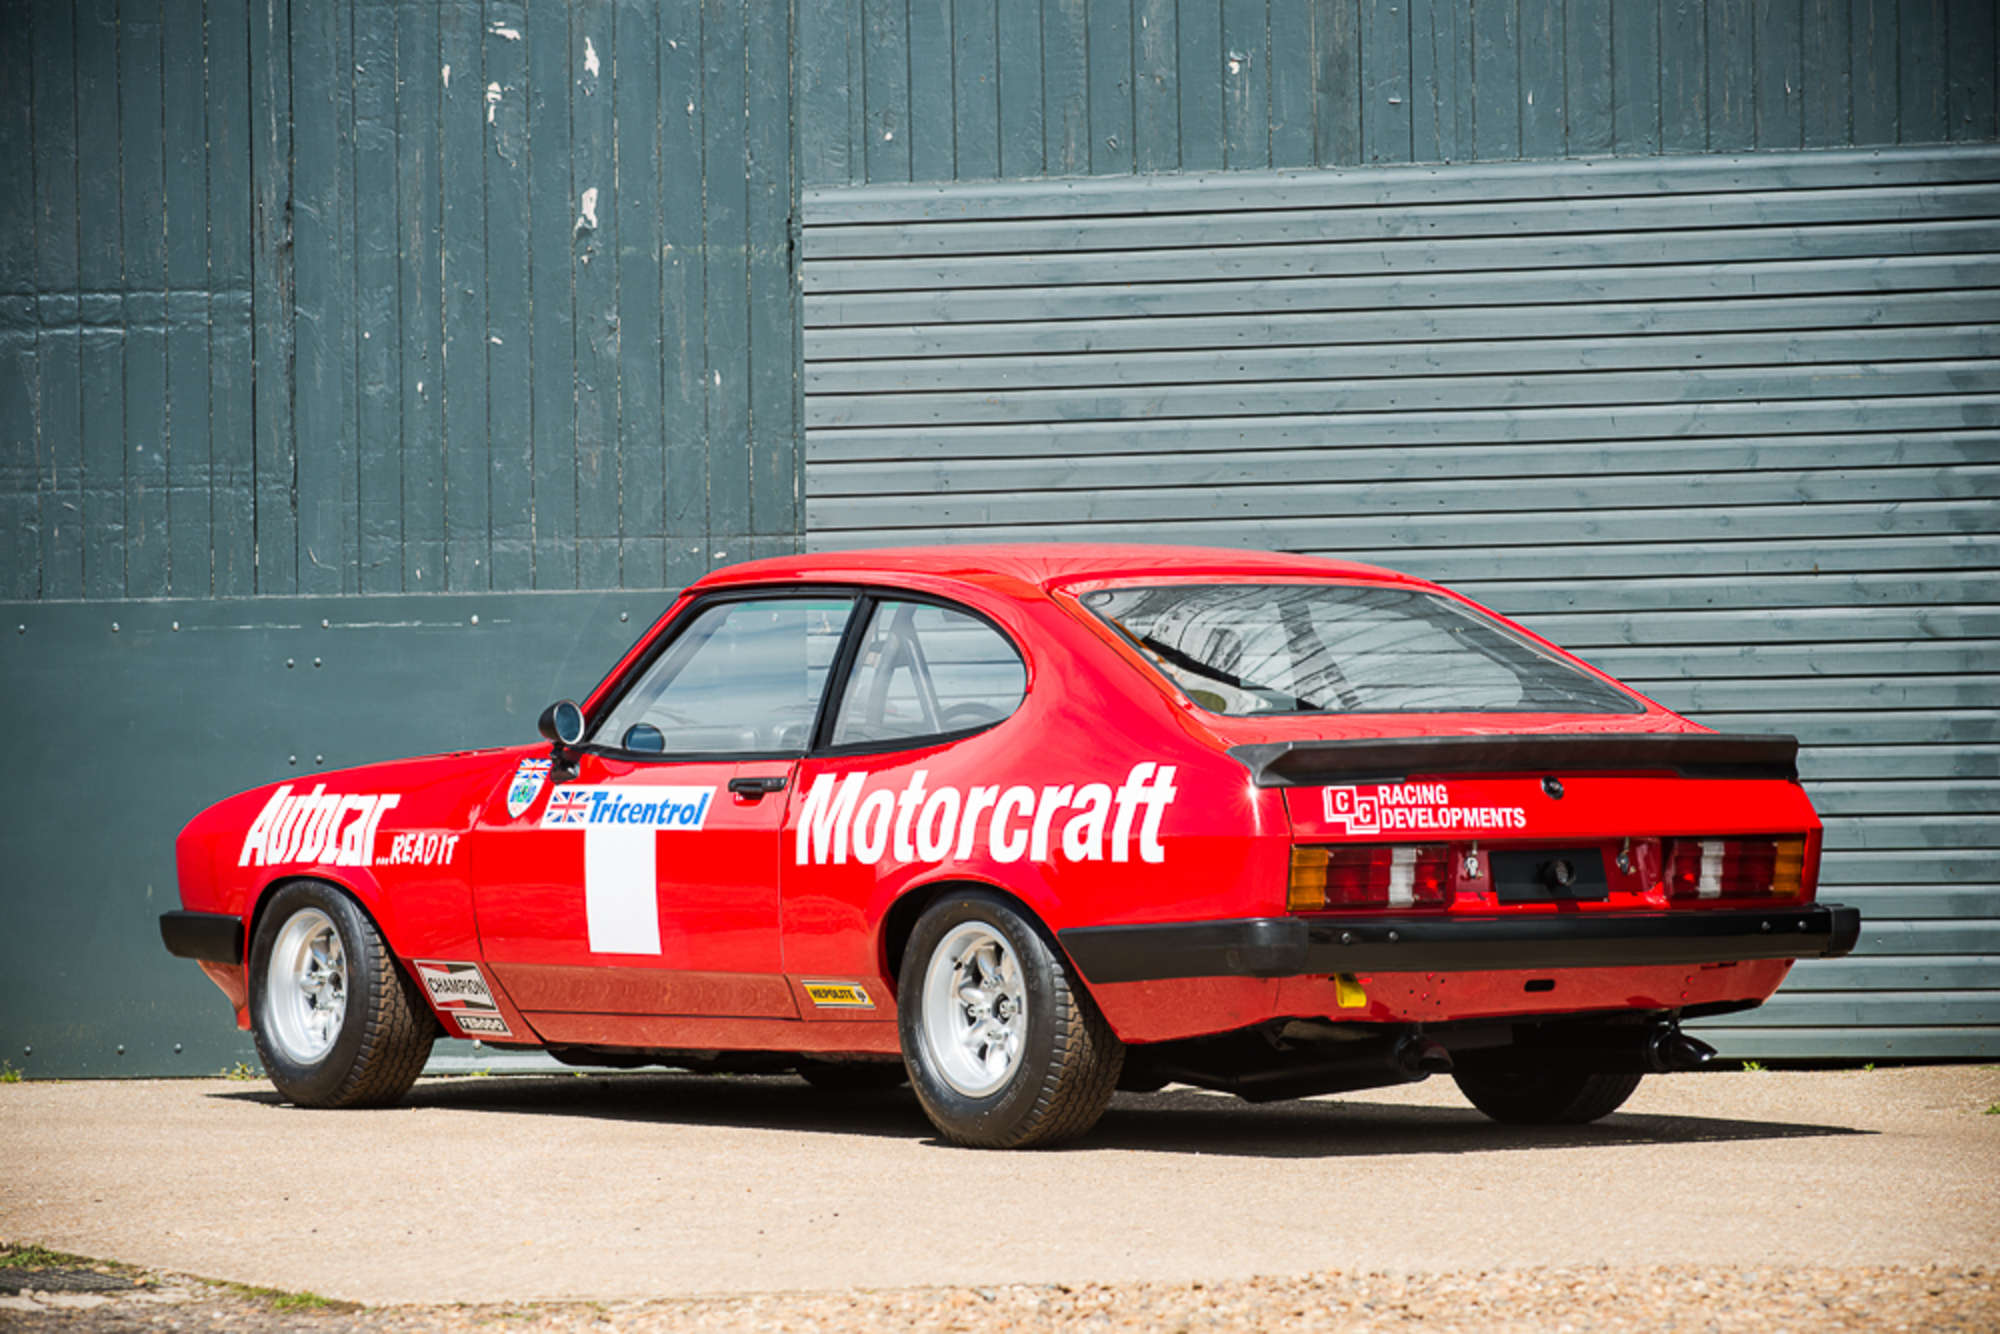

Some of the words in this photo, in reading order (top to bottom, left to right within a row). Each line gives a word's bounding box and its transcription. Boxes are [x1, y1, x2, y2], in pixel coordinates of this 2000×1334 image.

[589, 791, 710, 826] Tricentrol
[1378, 785, 1448, 805] RACING
[238, 783, 401, 866] Autocar
[796, 762, 1177, 864] Motorcraft
[1381, 806, 1526, 829] DEVELOPMENTS
[428, 977, 487, 995] CHAMPION
